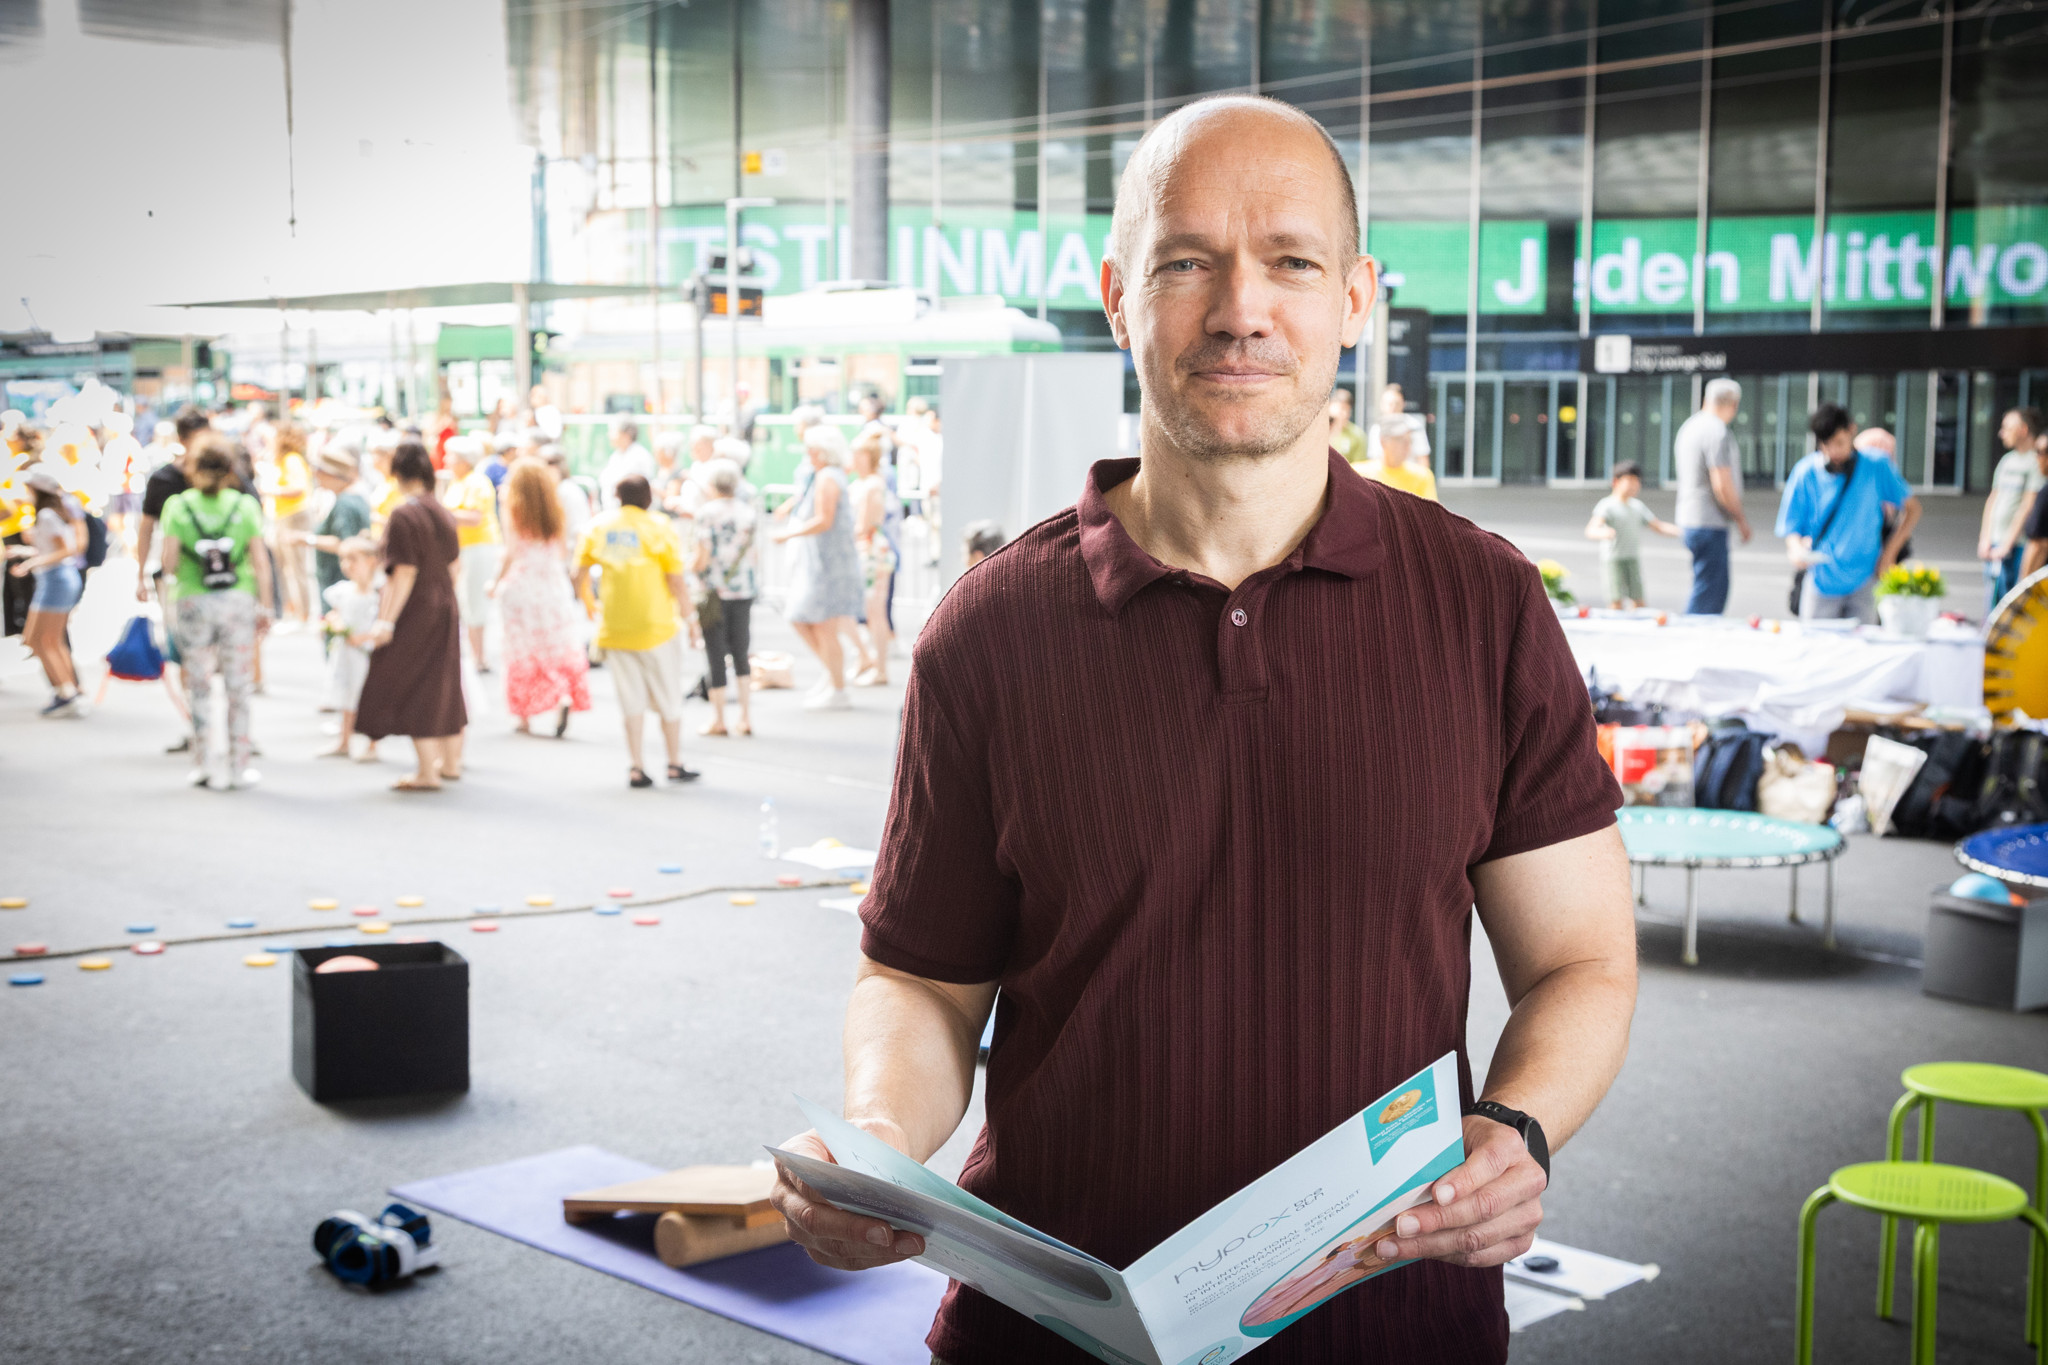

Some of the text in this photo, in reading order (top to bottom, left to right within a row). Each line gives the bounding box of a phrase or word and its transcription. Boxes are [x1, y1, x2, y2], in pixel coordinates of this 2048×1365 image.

[1493, 237, 1740, 305] Jden
[1182, 1279, 1212, 1300] YOUR
[1216, 1228, 1299, 1280] INTERNATIONAL
[1304, 1189, 1361, 1228] SPECIALIST
[1184, 1294, 1196, 1304] IN
[1304, 1202, 1350, 1233] SYSTEMS
